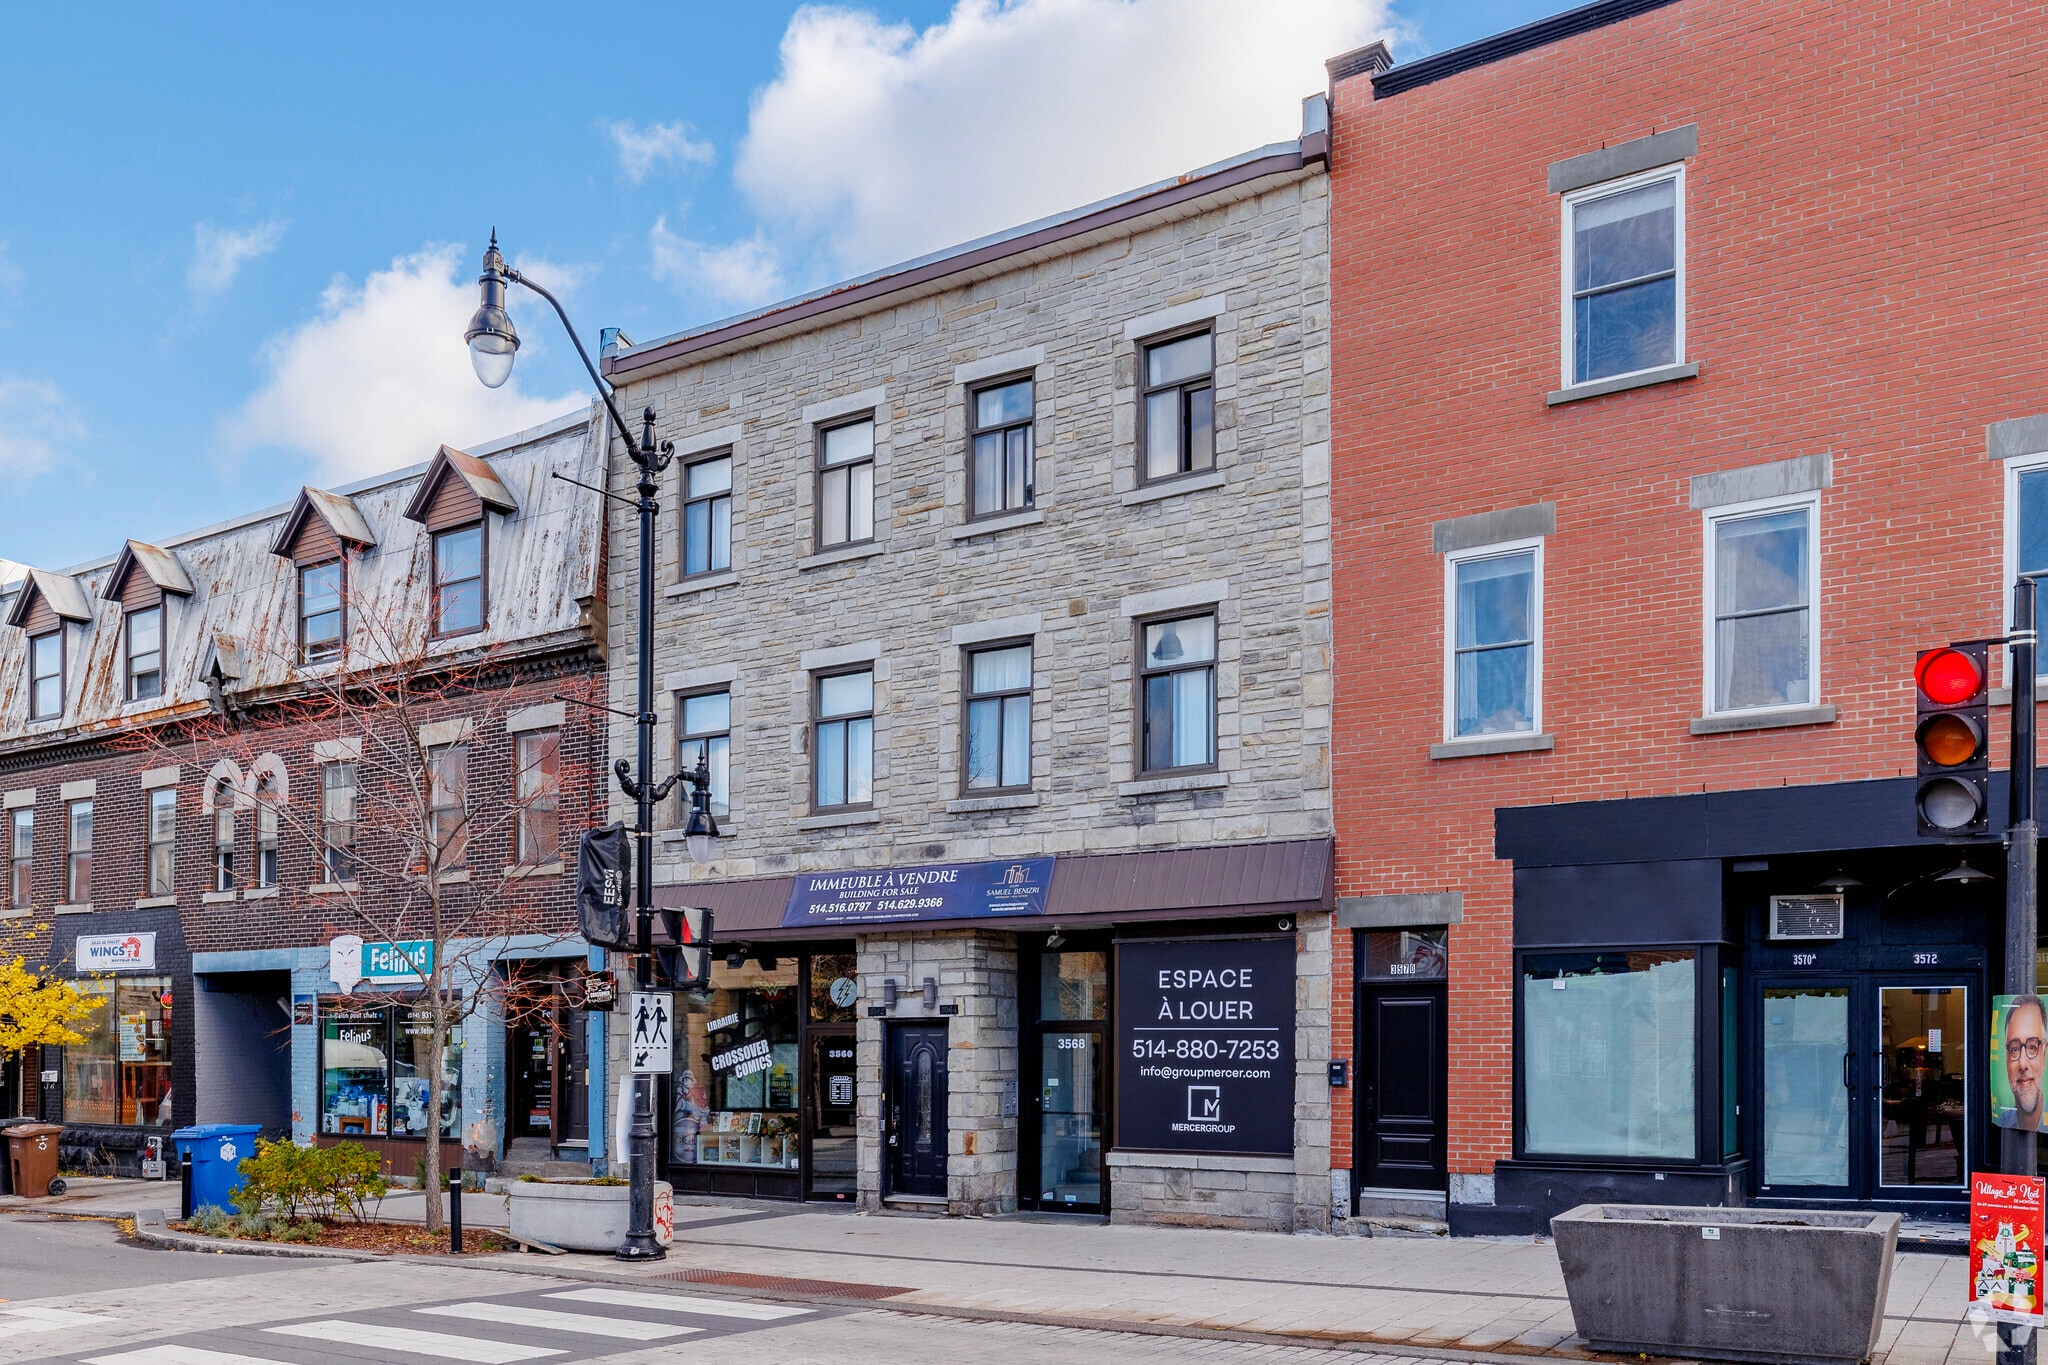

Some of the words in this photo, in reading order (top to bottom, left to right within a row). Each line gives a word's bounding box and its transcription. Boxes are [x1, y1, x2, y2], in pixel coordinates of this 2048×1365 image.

[603, 868, 615, 905] EESM
[809, 875, 882, 892] IMMEUBLE
[884, 872, 895, 887] À
[899, 869, 959, 886] VENDRE
[839, 889, 880, 899] BUILDING
[881, 887, 899, 897] FOR
[900, 886, 919, 896] SALE
[986, 888, 1012, 896] SAMUEL
[1013, 887, 1040, 895] BENIZRI
[808, 901, 872, 914] 514.516.0797
[876, 897, 944, 911] 514.629.9366
[90, 946, 125, 957] WINGS
[371, 944, 425, 973] Felinus
[1913, 954, 1938, 964] 3572
[1390, 963, 1416, 975] 3570
[1159, 969, 1253, 988] ESPACE
[1158, 996, 1173, 1020] À
[1179, 1001, 1253, 1020] LOUER
[706, 1013, 739, 1032] LIBRAIRIE
[340, 1029, 371, 1043] Felinus
[1058, 1038, 1086, 1049] 3568
[711, 1039, 770, 1071] CROSSOVER
[828, 1050, 853, 1058] 3560
[1132, 1039, 1280, 1060] 514-880-7253
[735, 1054, 773, 1078] COMICS
[1140, 1066, 1271, 1079] info@groupmercer.com
[1171, 1123, 1236, 1133] MERCERGROUP
[1975, 1181, 2004, 1199] Village
